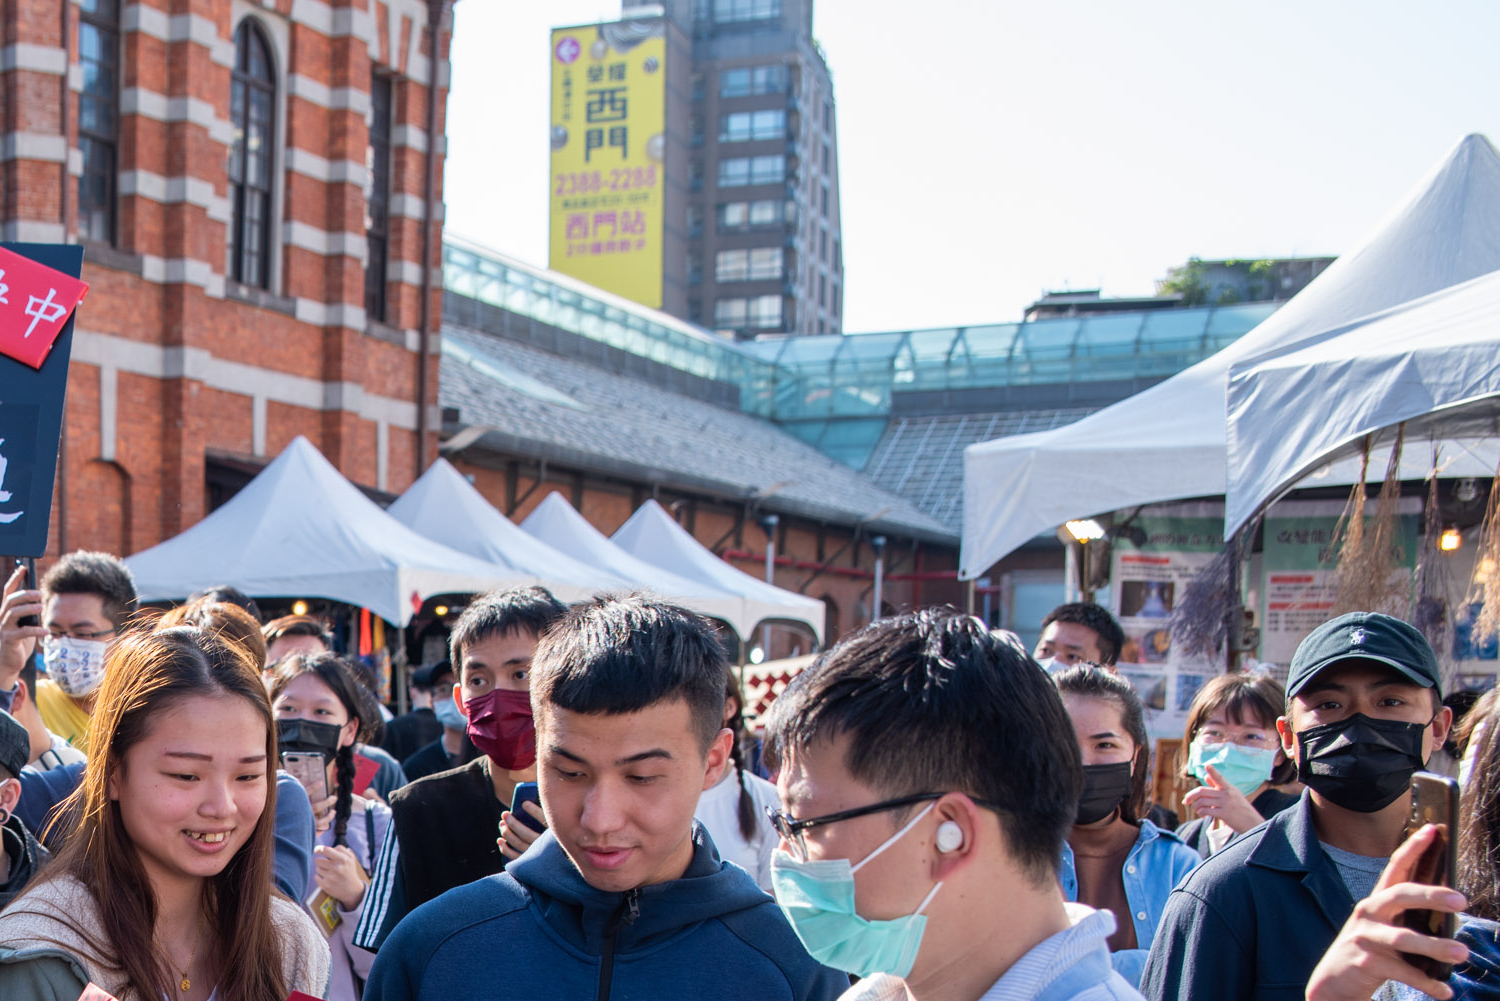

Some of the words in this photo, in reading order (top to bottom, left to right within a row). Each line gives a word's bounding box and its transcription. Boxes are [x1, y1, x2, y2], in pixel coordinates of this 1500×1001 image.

[585, 87, 629, 163] 西門
[555, 165, 658, 196] 2388-2288
[565, 209, 647, 240] 西門站
